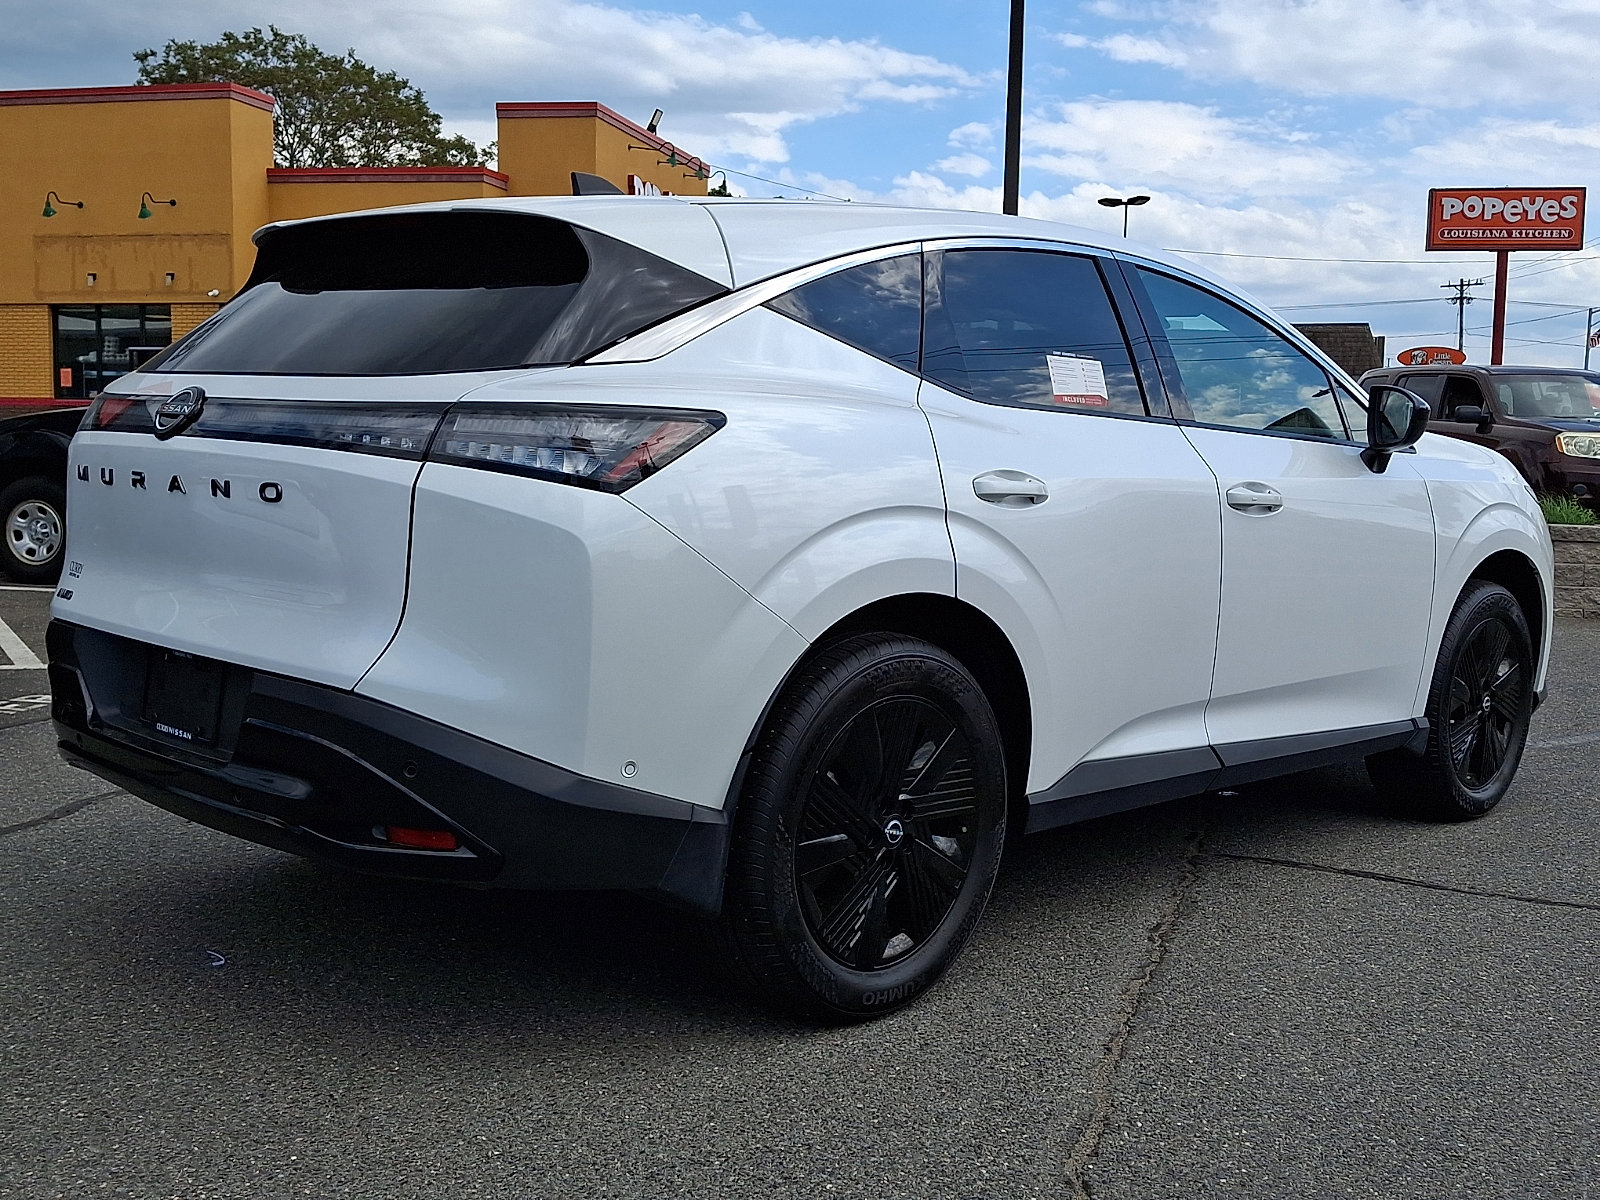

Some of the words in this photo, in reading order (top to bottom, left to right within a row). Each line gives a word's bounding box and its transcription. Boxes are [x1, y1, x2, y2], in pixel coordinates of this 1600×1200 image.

[1443, 229, 1508, 239] LOUISIANA
[1511, 229, 1570, 239] KITCHEN
[77, 464, 283, 503] MURANO
[168, 726, 192, 741] NISSAN
